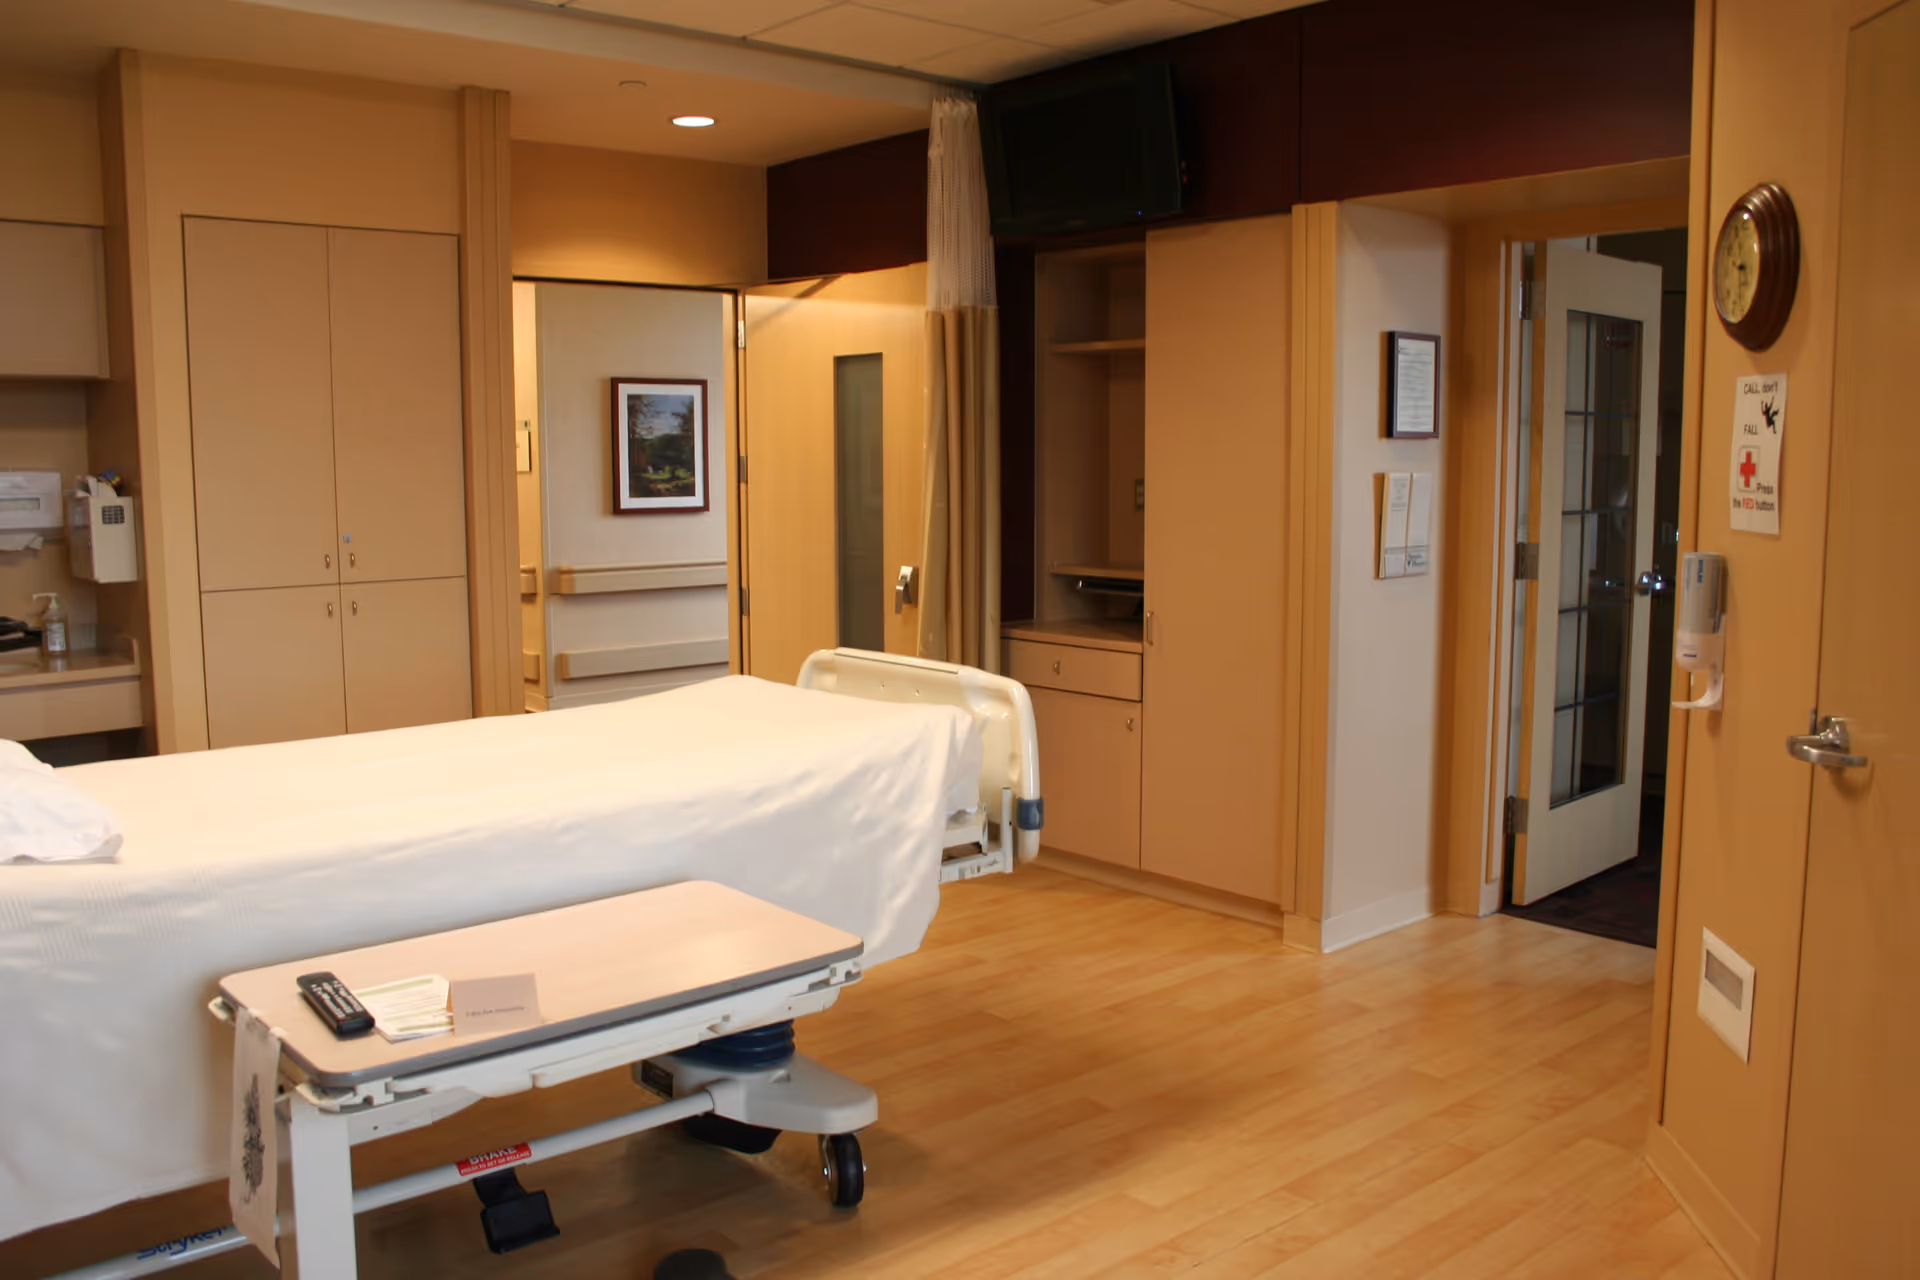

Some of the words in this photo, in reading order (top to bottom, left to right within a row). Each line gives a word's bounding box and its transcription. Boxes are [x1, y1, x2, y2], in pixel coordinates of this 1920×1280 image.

[1743, 424, 1758, 436] FALL
[1742, 497, 1755, 509] RED
[469, 1147, 517, 1165] BRAKE
